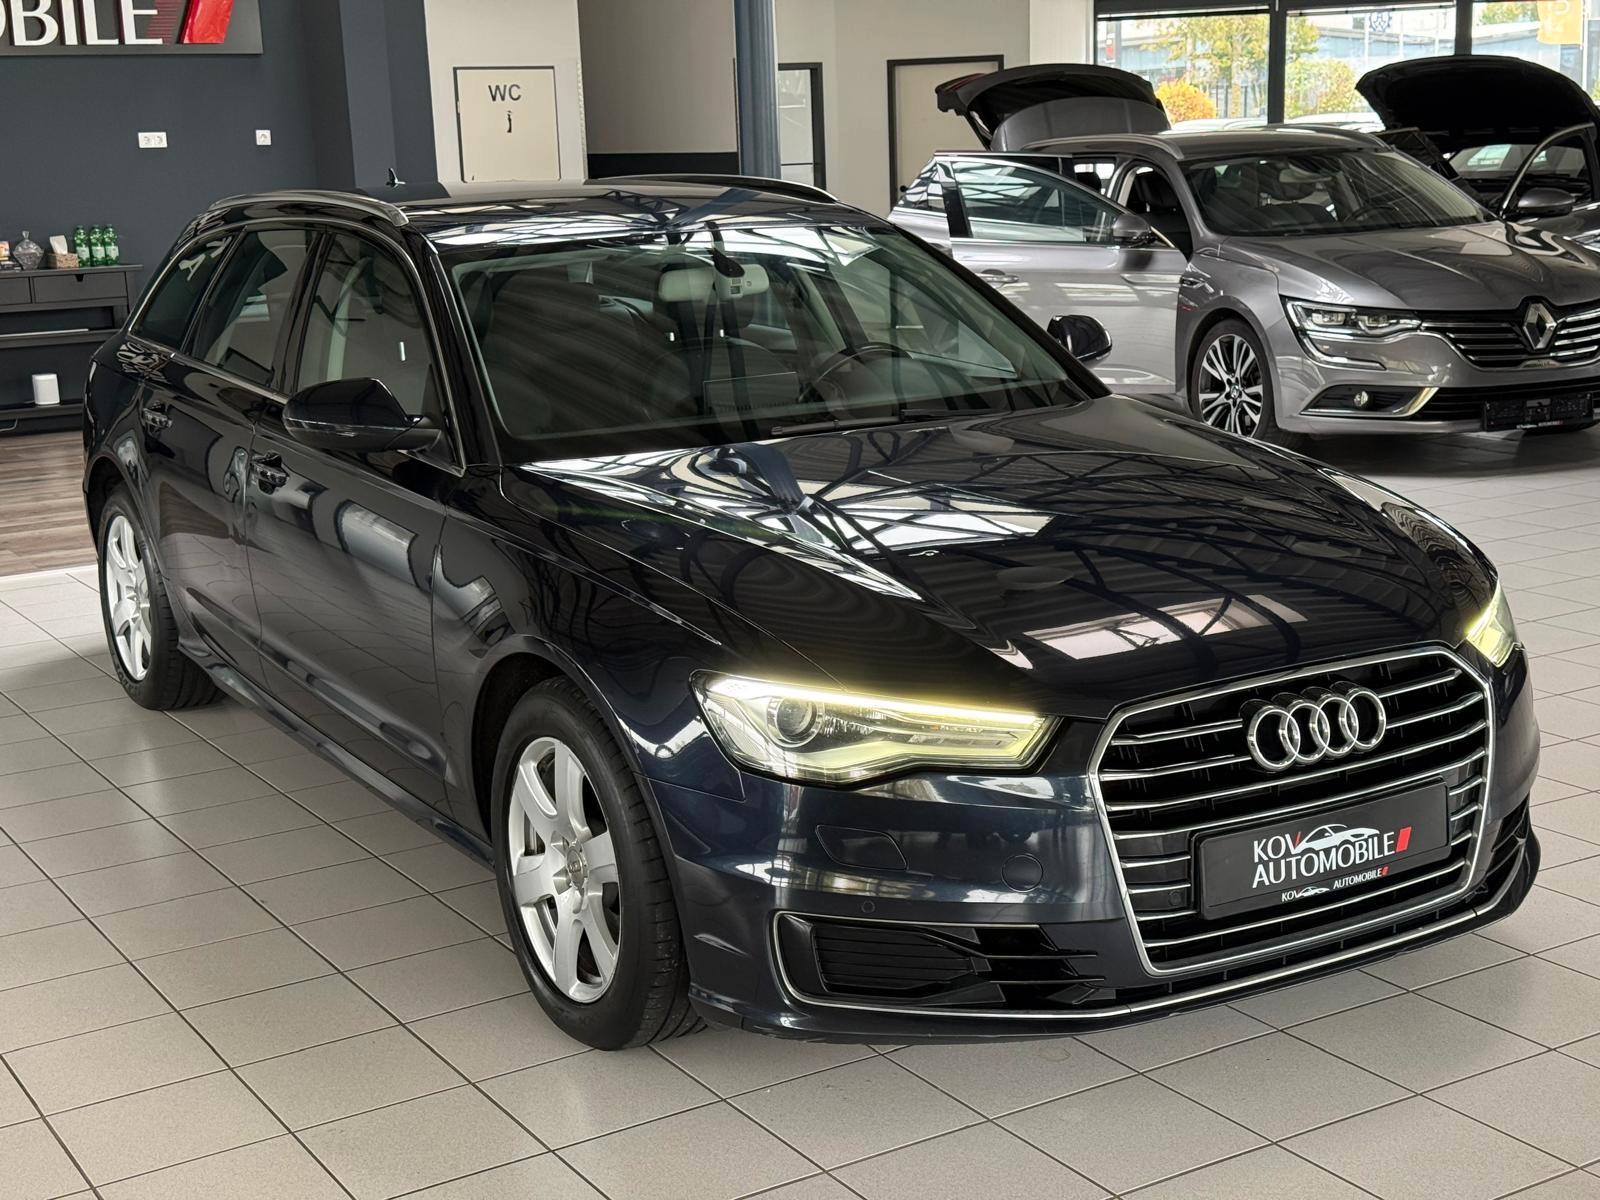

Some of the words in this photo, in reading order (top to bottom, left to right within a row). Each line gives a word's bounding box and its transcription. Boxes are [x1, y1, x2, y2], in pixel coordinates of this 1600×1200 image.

[0, 0, 163, 46] BILE
[488, 84, 521, 102] WC
[1252, 832, 1396, 888] AUTOMOBILE
[1253, 832, 1302, 863] KOV
[1333, 868, 1383, 889] AUTOMOBILE
